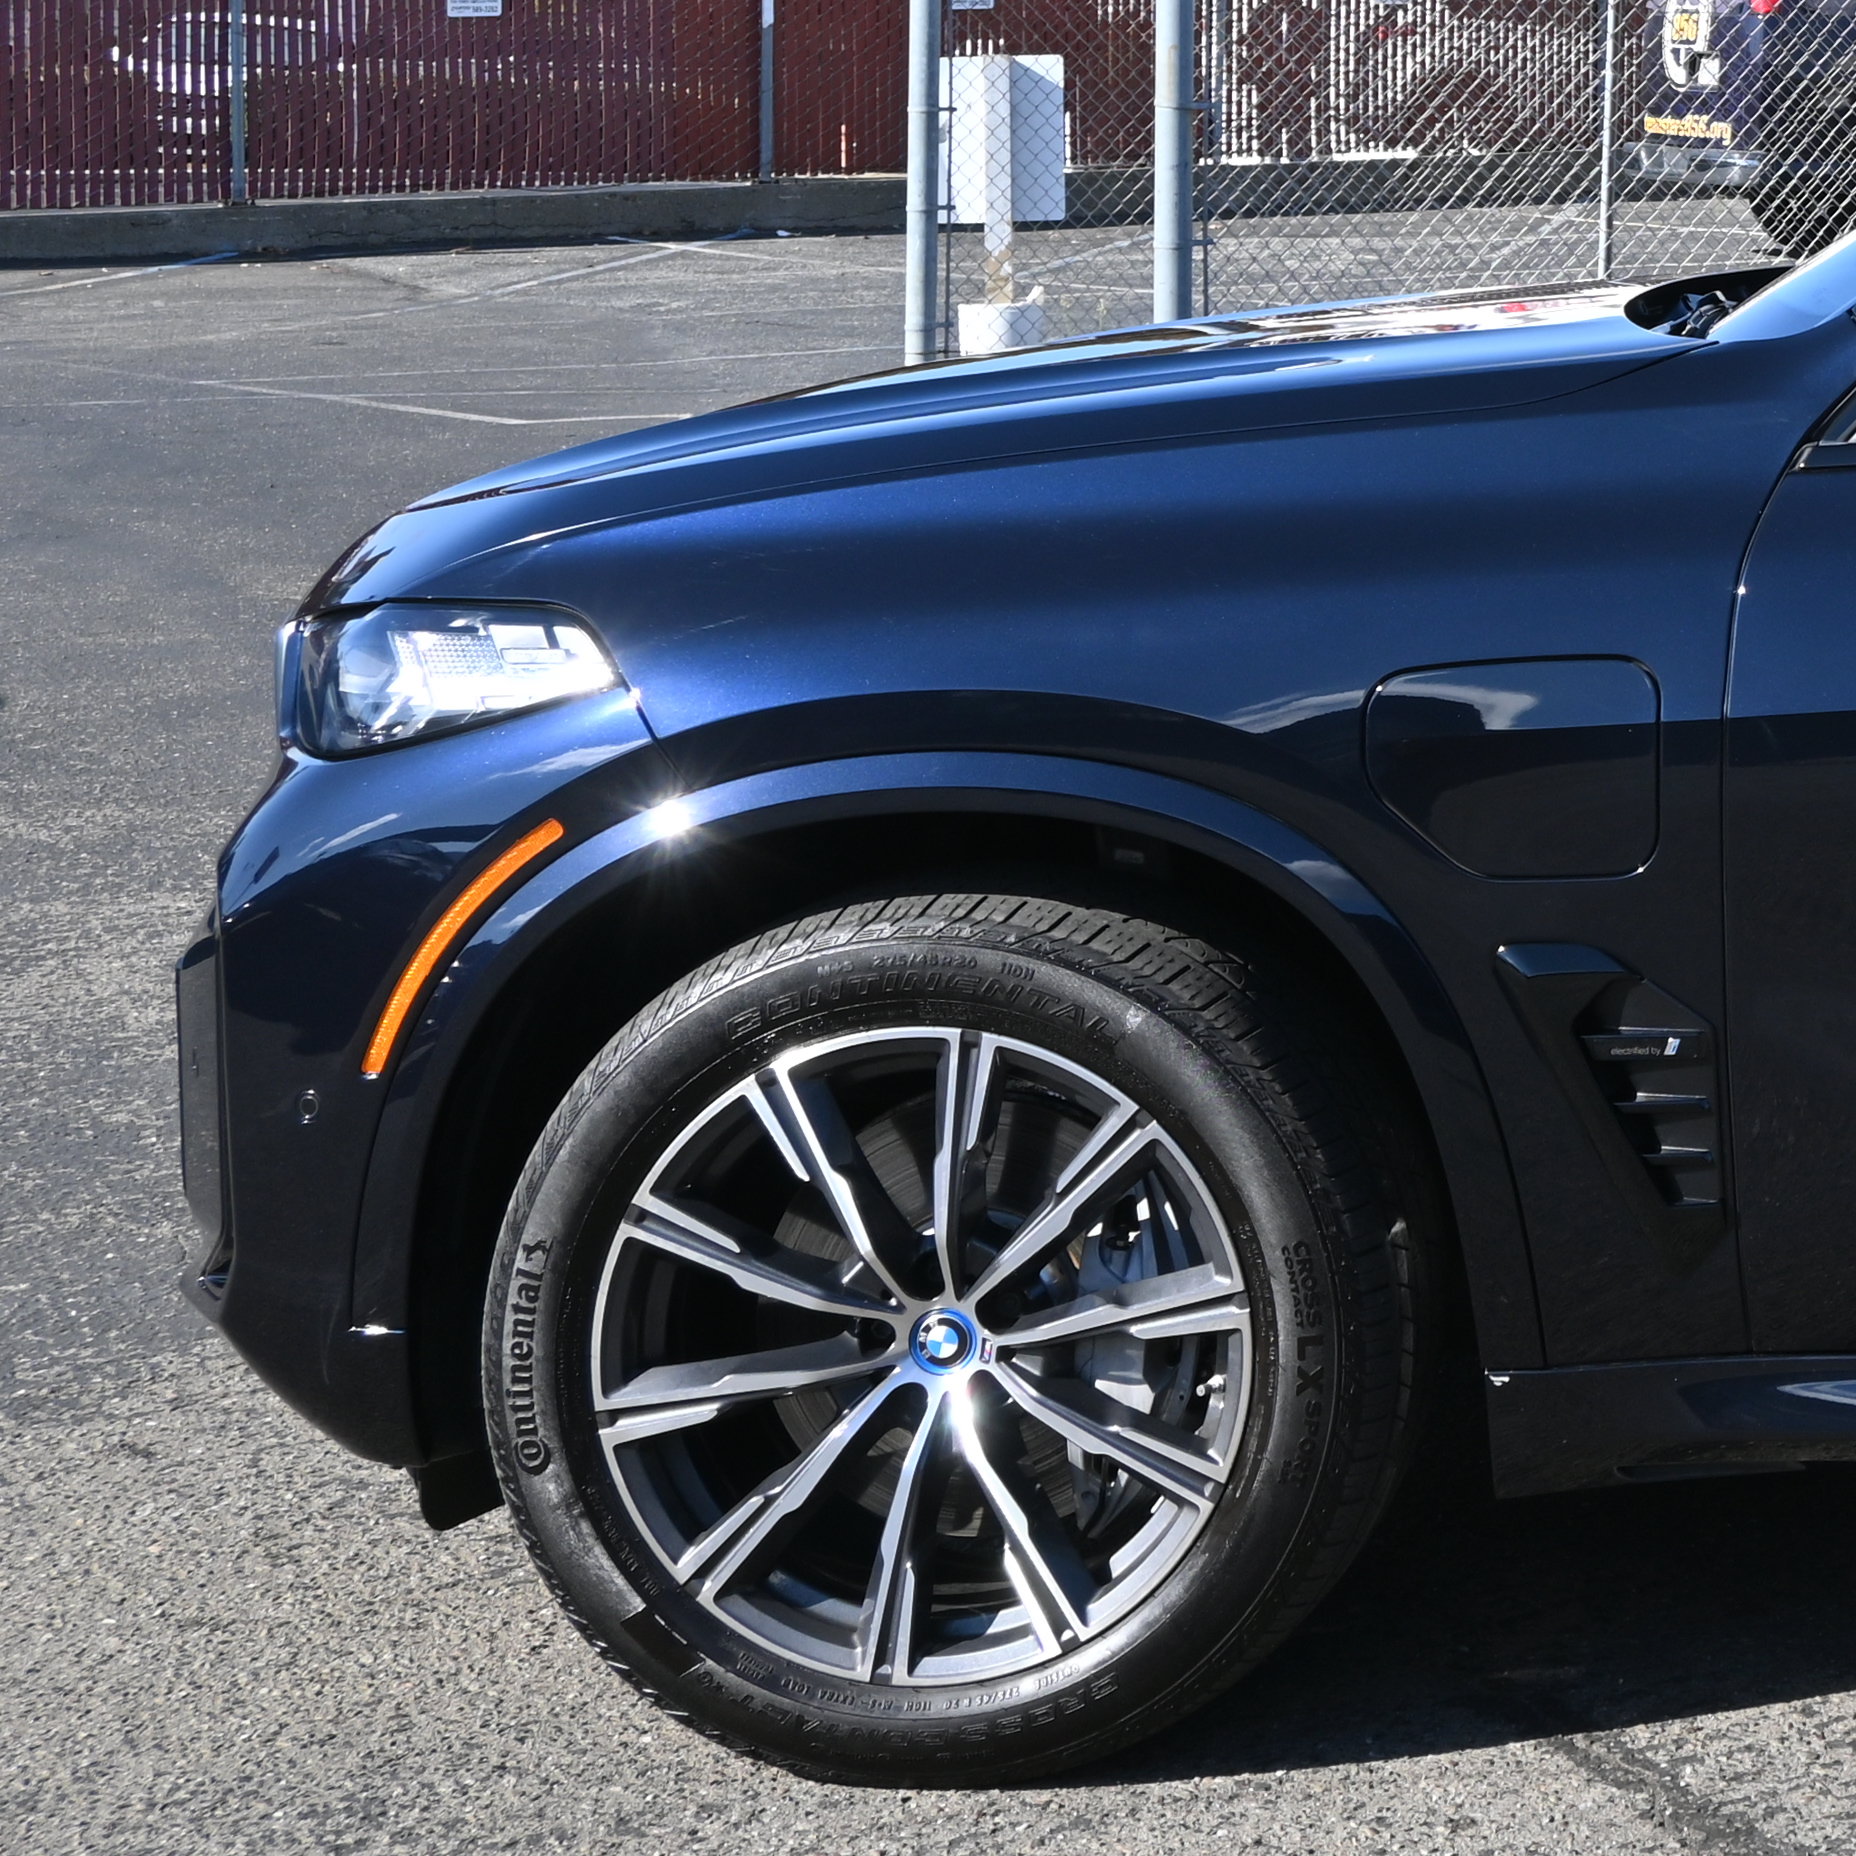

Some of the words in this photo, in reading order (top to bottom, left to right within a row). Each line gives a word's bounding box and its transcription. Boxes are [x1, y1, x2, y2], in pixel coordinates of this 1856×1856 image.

[724, 970, 1122, 1044] CONTINENTAL
[1281, 1245, 1305, 1330] CONTACT
[1291, 1240, 1323, 1330] CROSS
[506, 1266, 551, 1477] Continental
[1291, 1398, 1322, 1486] SPORT
[960, 1672, 1120, 1743] CROSS
